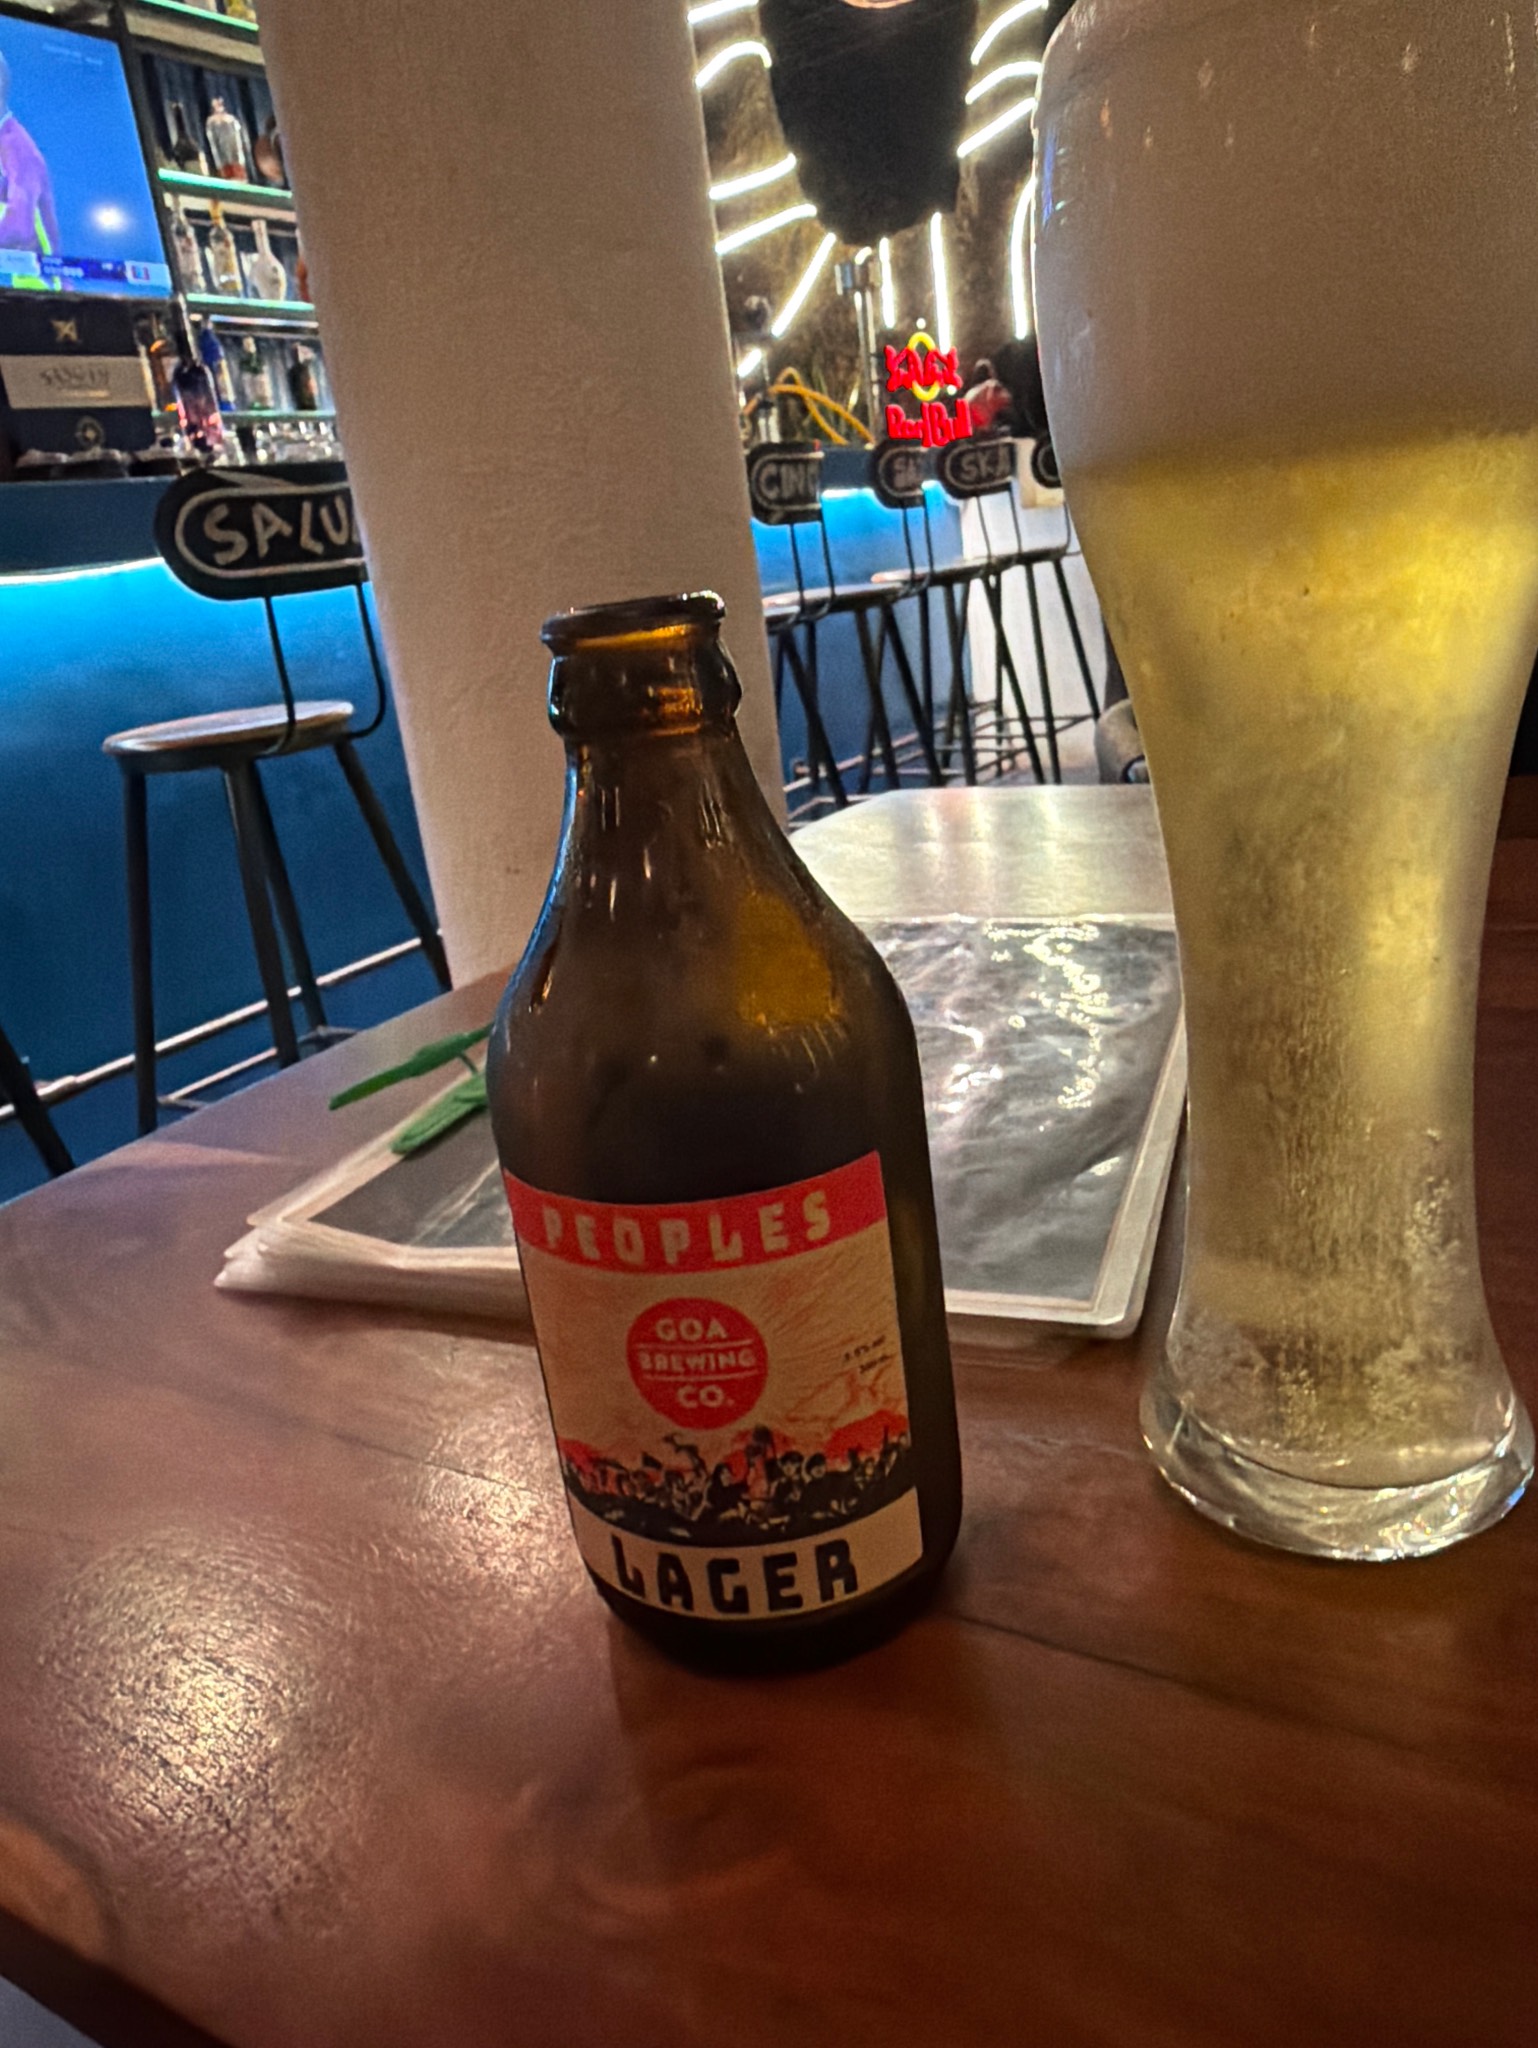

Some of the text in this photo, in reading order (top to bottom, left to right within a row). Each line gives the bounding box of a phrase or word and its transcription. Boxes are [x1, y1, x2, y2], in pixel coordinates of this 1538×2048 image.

[884, 398, 973, 447] Red Bull
[203, 495, 359, 565] SALU
[542, 1190, 832, 1266] PEOPLES
[655, 1317, 728, 1341] GOA
[639, 1348, 756, 1373] BREWING
[677, 1384, 735, 1408] CO.
[610, 1533, 859, 1614] LAGER
